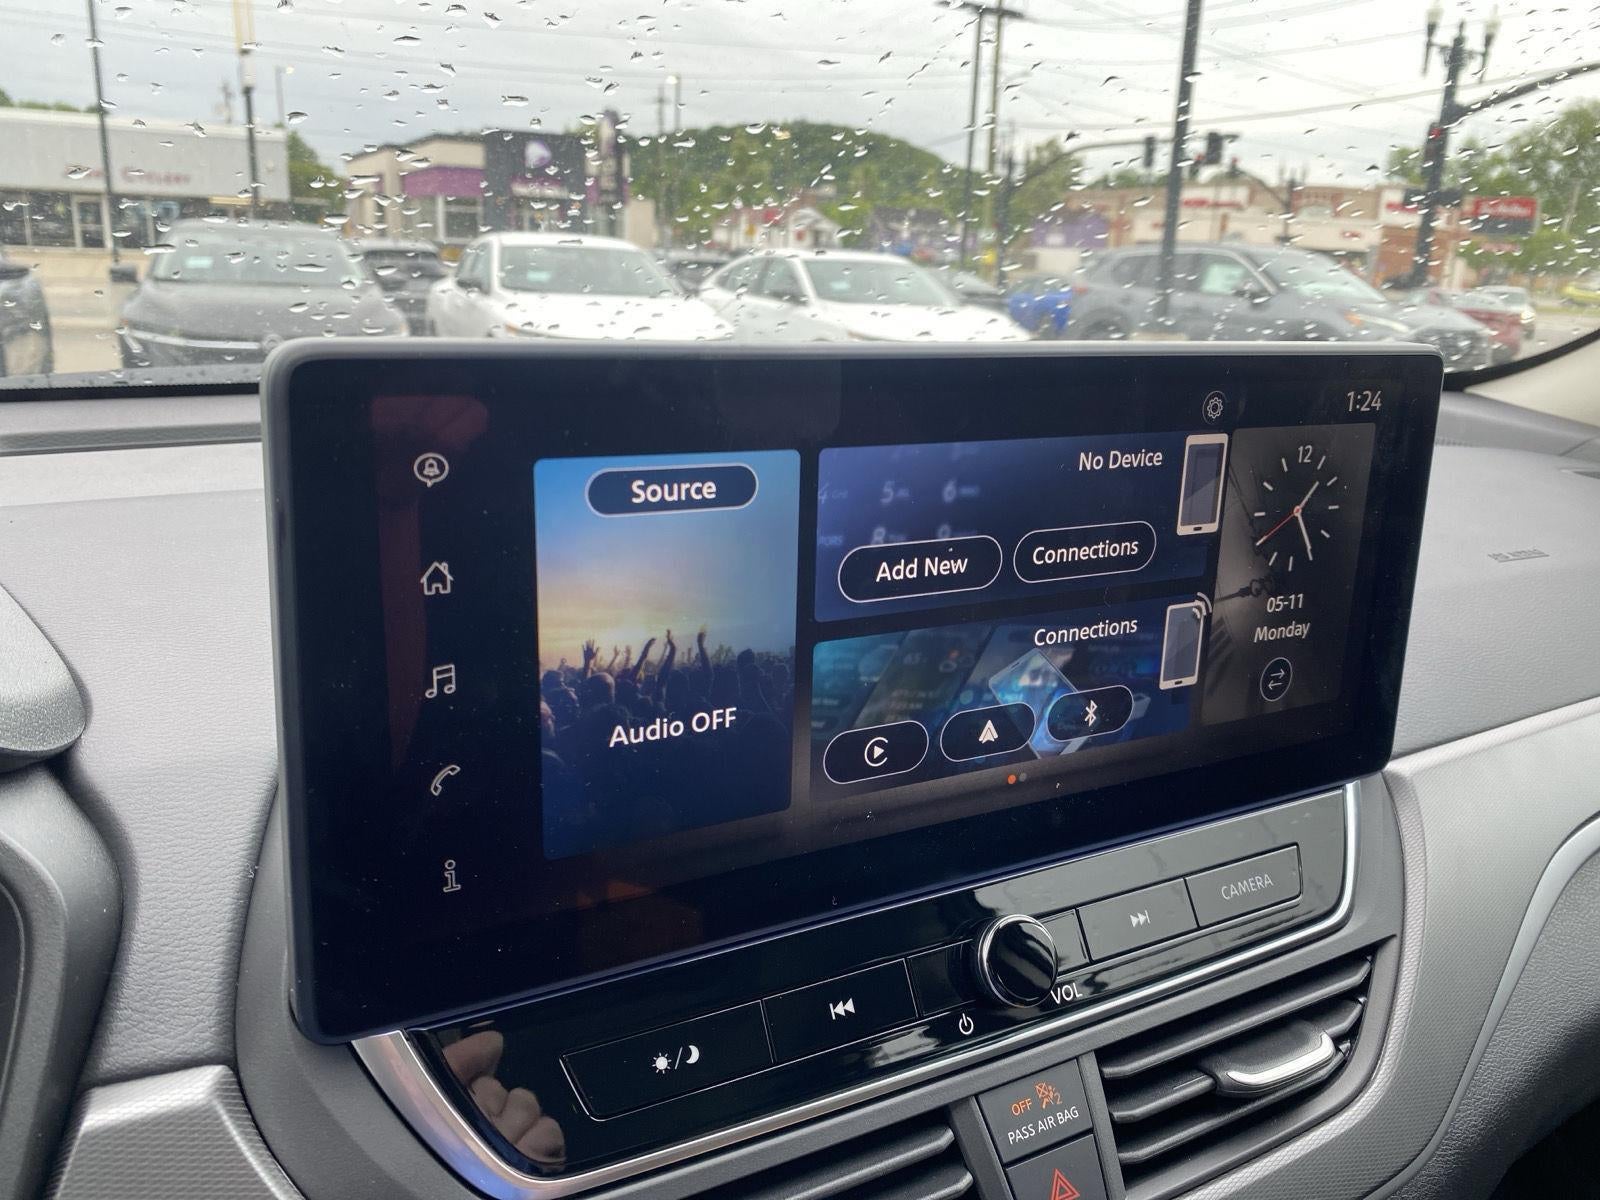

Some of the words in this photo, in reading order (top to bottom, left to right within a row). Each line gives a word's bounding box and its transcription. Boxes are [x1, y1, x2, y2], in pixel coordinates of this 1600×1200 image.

[1347, 390, 1381, 412] 1:24
[1078, 451, 1104, 472] No
[1108, 447, 1164, 470] Device
[1297, 444, 1313, 464] 12
[630, 478, 717, 504] Source
[880, 481, 895, 504] 5
[942, 478, 957, 503] 6
[1031, 538, 1139, 564] Connections
[875, 557, 918, 583] Add
[923, 556, 968, 578] New
[1266, 592, 1305, 614] 05-11
[1033, 616, 1138, 647] Connections
[1253, 620, 1311, 643] Monday
[608, 716, 685, 748] Audio
[690, 706, 738, 733] OFF
[1221, 873, 1274, 900] CAMERA
[1051, 982, 1083, 1004] VOL
[1010, 1097, 1033, 1116] OFF
[1007, 1123, 1036, 1145] PASS
[1038, 1116, 1057, 1134] AIR
[1056, 1106, 1079, 1125] BAG
